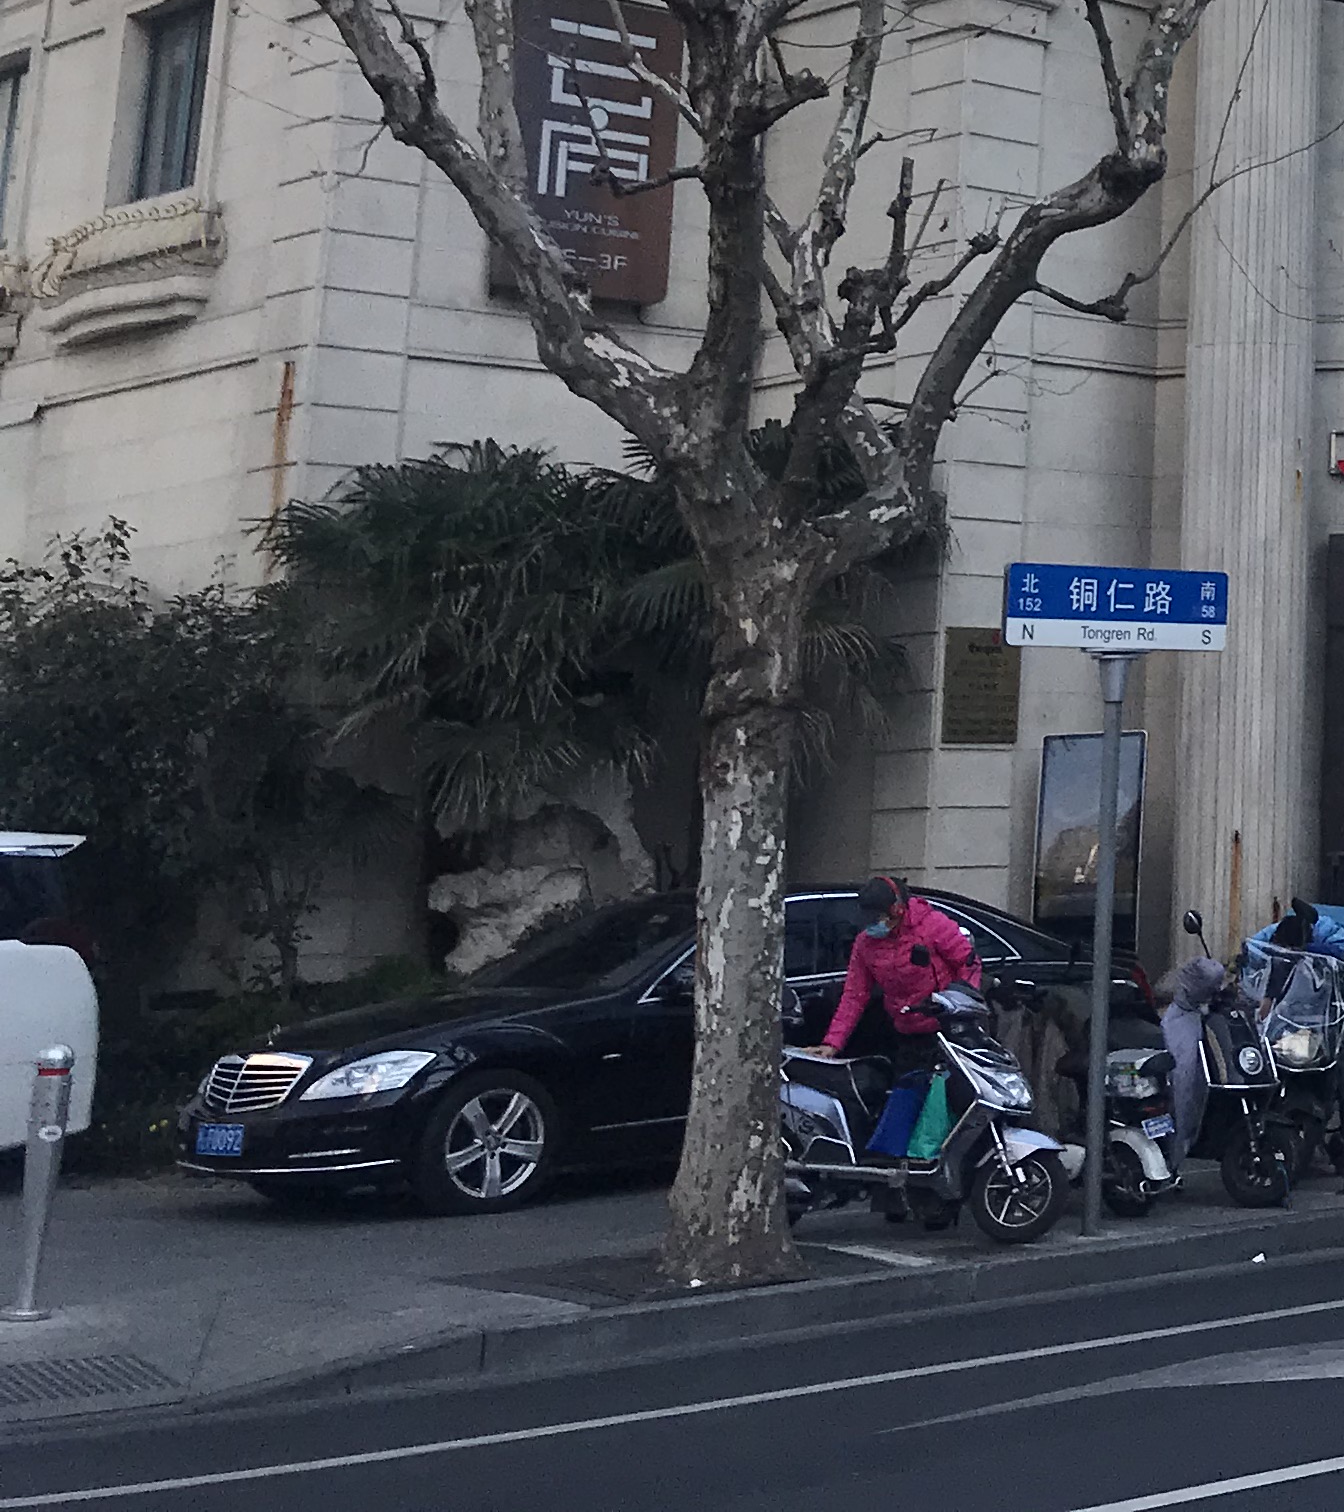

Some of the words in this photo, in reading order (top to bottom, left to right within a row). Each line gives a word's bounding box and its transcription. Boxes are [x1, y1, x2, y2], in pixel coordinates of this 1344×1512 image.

[564, 209, 620, 226] YUN'S
[1021, 573, 1040, 594] 北
[1069, 577, 1173, 615] 铜仁路
[1200, 581, 1216, 602] 南
[1018, 597, 1042, 612] 152
[1201, 604, 1216, 619] 58
[1021, 623, 1035, 641] N
[1081, 625, 1131, 644] Tongren
[1201, 629, 1212, 646] S
